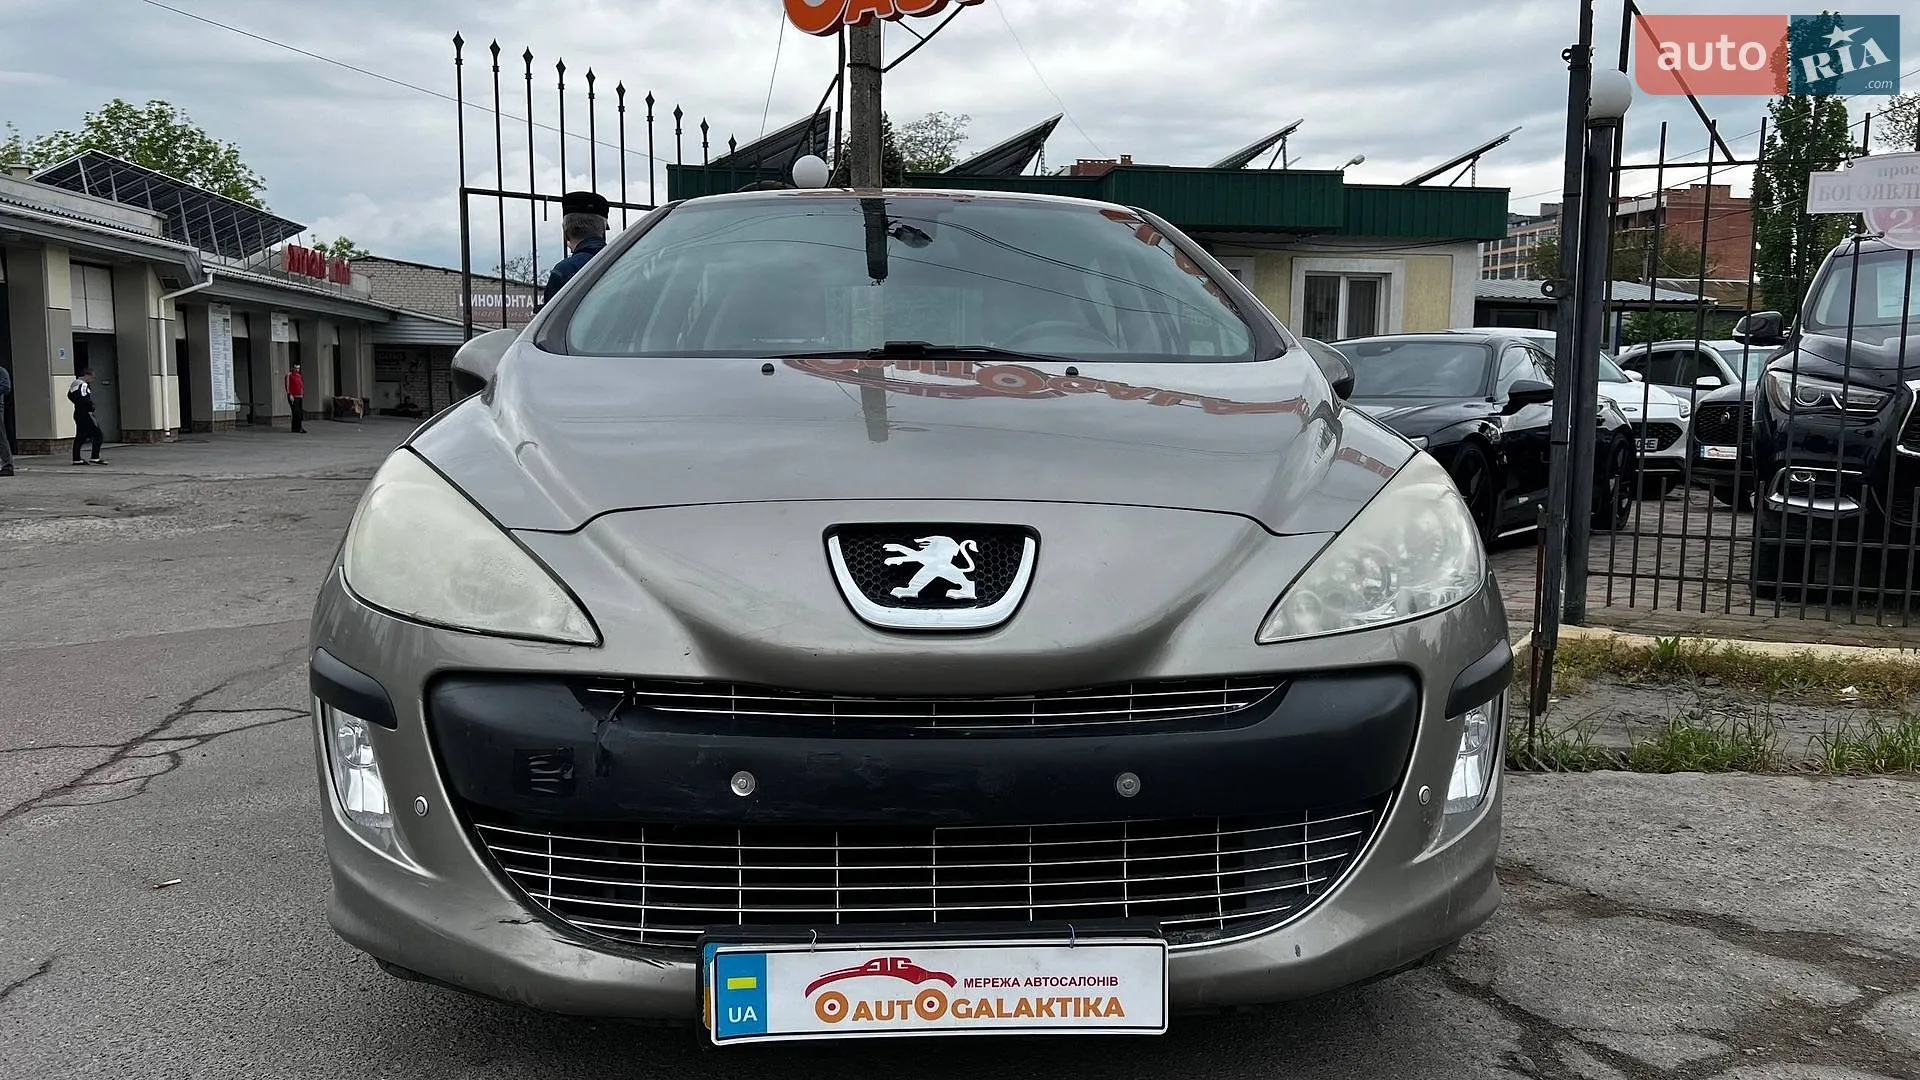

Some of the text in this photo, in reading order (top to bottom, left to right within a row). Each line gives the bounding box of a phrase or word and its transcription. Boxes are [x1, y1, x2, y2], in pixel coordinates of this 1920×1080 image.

[1819, 183, 1920, 201] БОГОЯВЛ
[963, 976, 1119, 988] МЕРЕЖА АВТОСАЛОНІВ
[728, 1005, 758, 1023] UA
